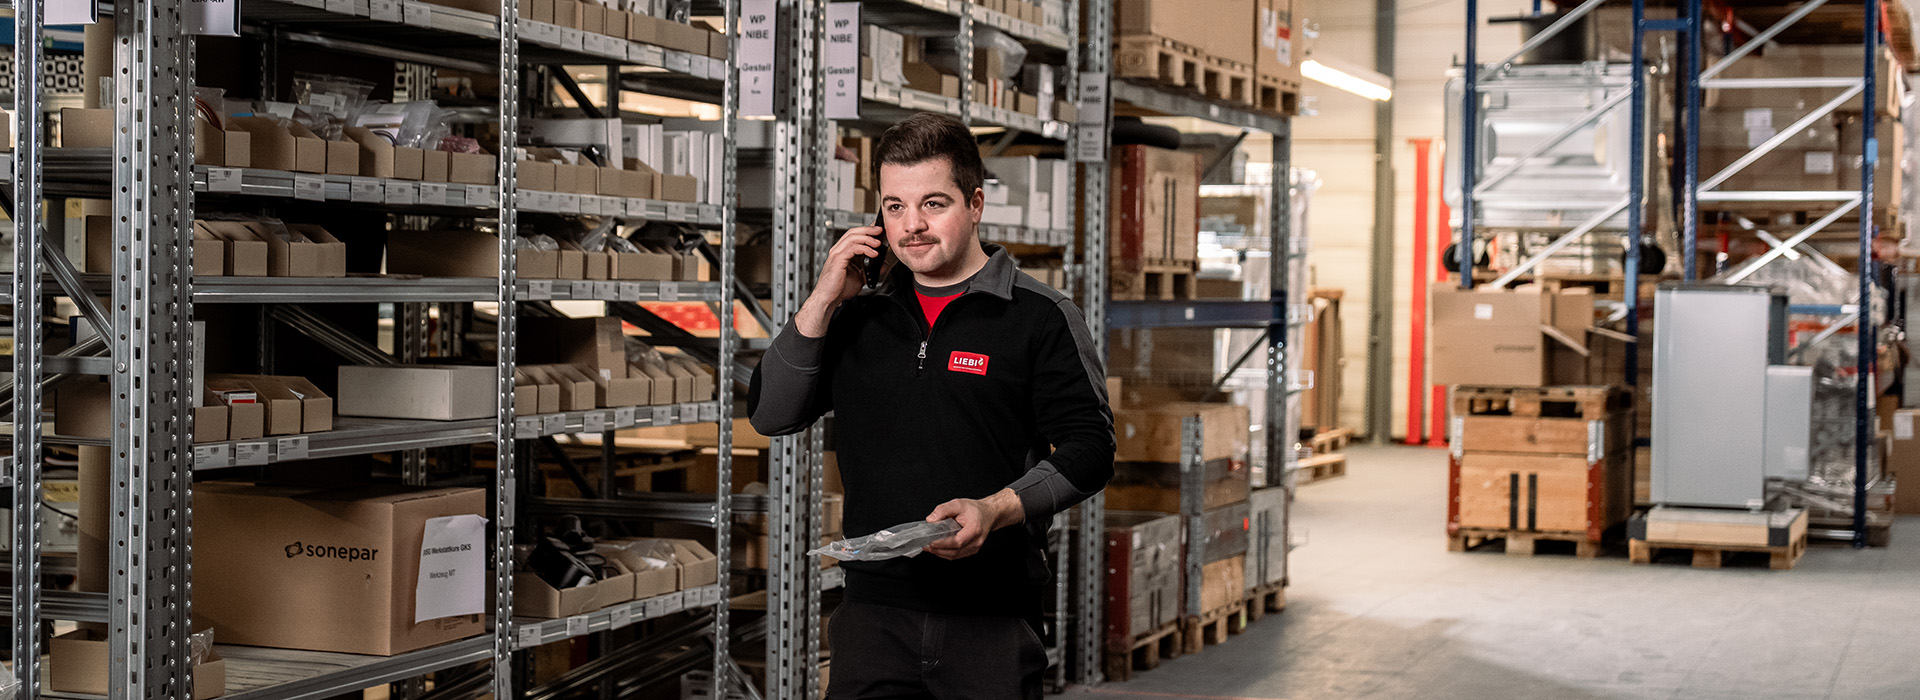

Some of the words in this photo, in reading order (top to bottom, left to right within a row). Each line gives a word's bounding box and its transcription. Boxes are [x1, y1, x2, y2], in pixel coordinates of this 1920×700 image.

[749, 14, 766, 23] WP
[833, 19, 849, 28] WP
[745, 30, 769, 39] NIBE
[830, 34, 852, 43] NIBE
[742, 62, 771, 72] Gestell
[827, 66, 855, 75] Gestell
[753, 76, 760, 85] F
[460, 543, 472, 552] GKS
[306, 544, 379, 562] sonepar
